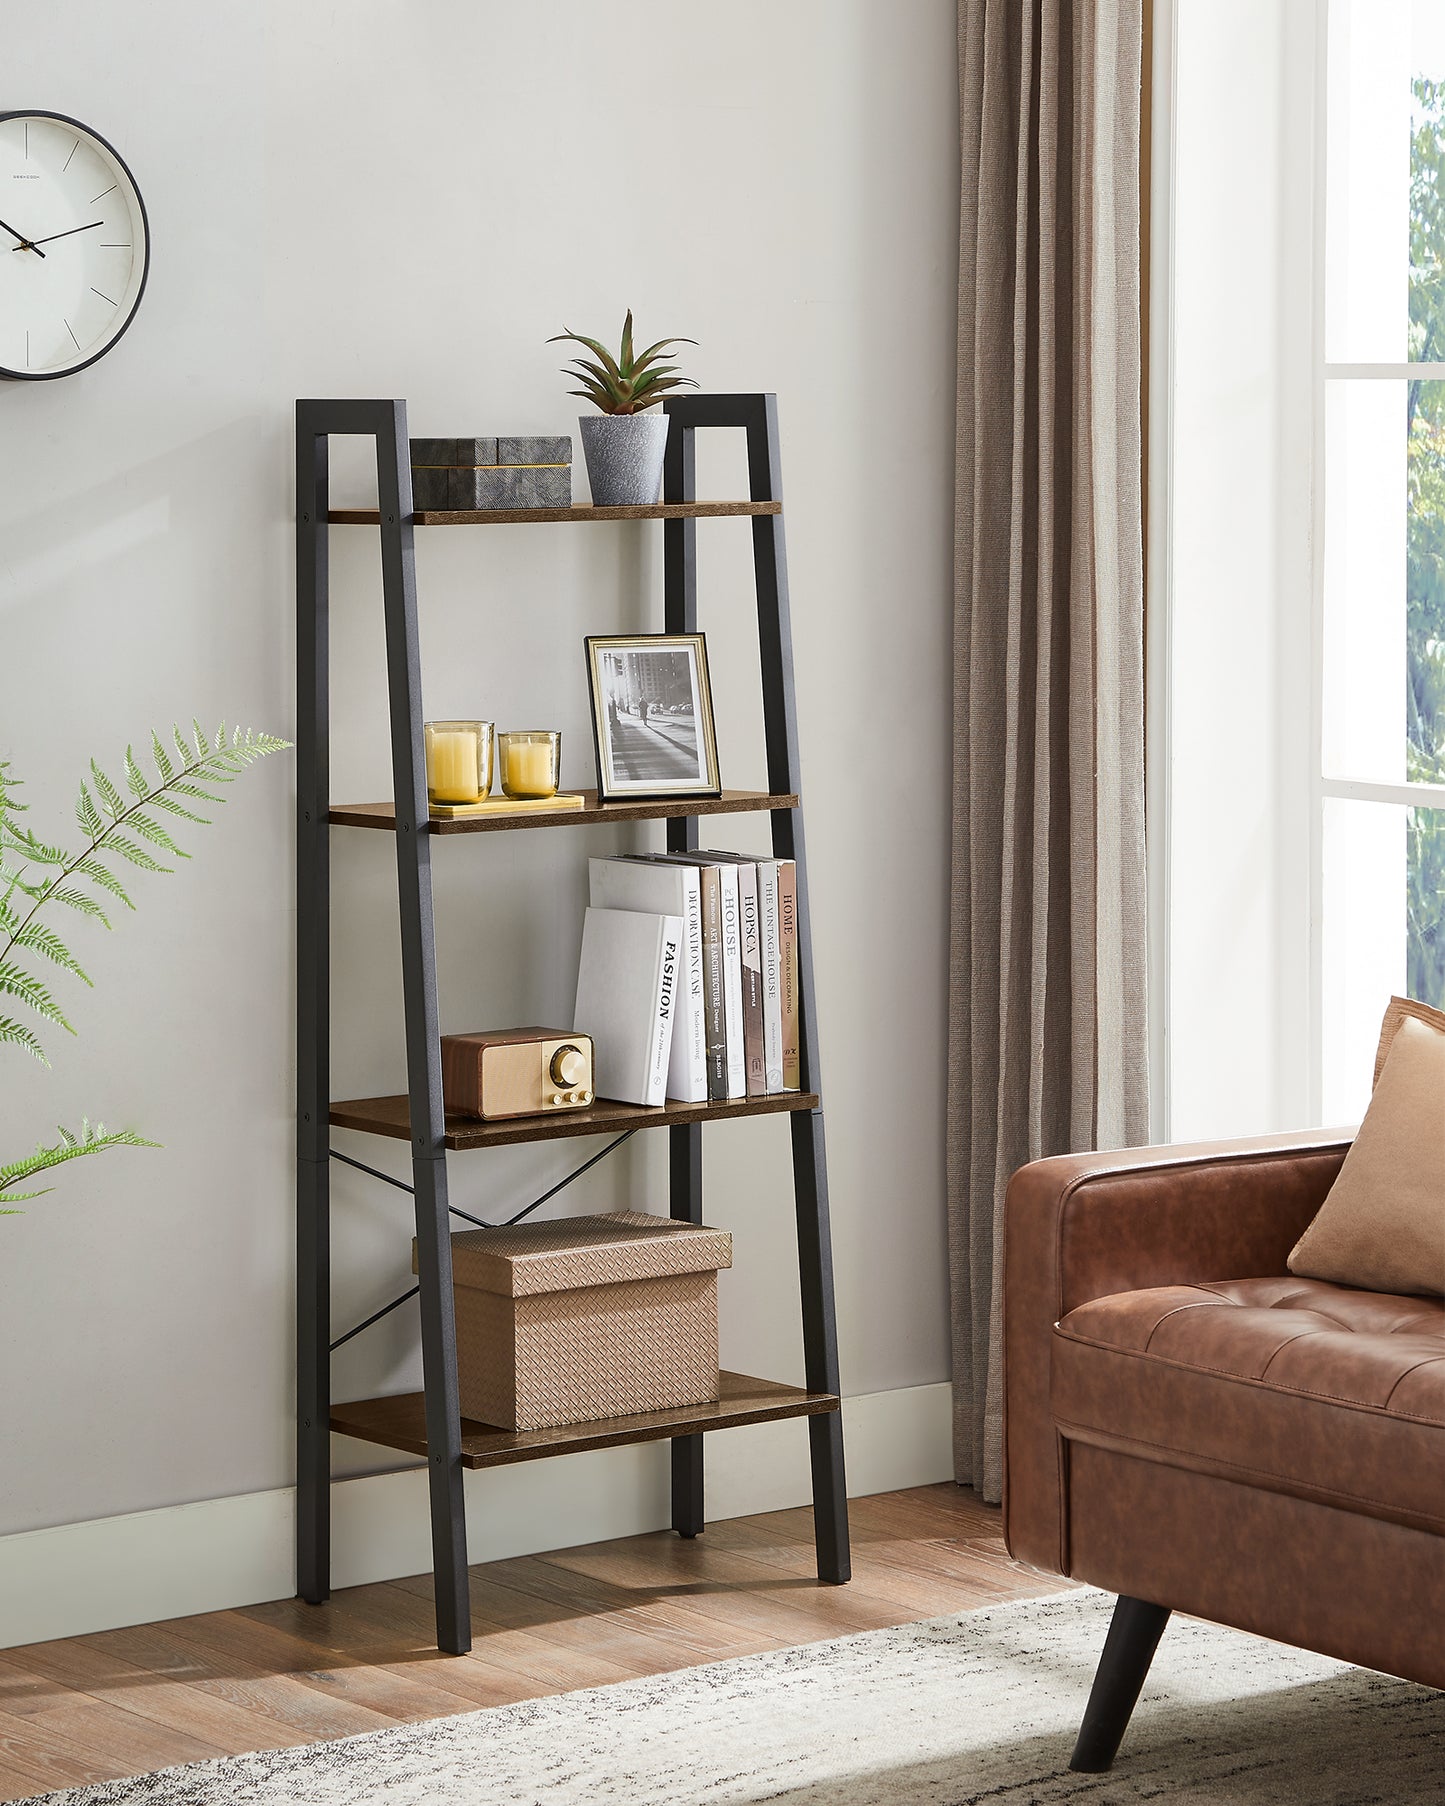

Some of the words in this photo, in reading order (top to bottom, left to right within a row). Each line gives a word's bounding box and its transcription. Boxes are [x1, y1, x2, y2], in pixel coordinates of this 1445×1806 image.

[688, 890, 699, 966] DECORATION
[726, 898, 736, 956] HOUSE
[745, 896, 756, 954] HOPSCA
[767, 907, 775, 957] VINTAGE
[783, 895, 792, 935] HOME
[660, 942, 676, 1019] FASHION
[691, 970, 700, 999] CASE
[711, 950, 720, 1007] ARCHITECTURE
[768, 960, 776, 998] HOUSE
